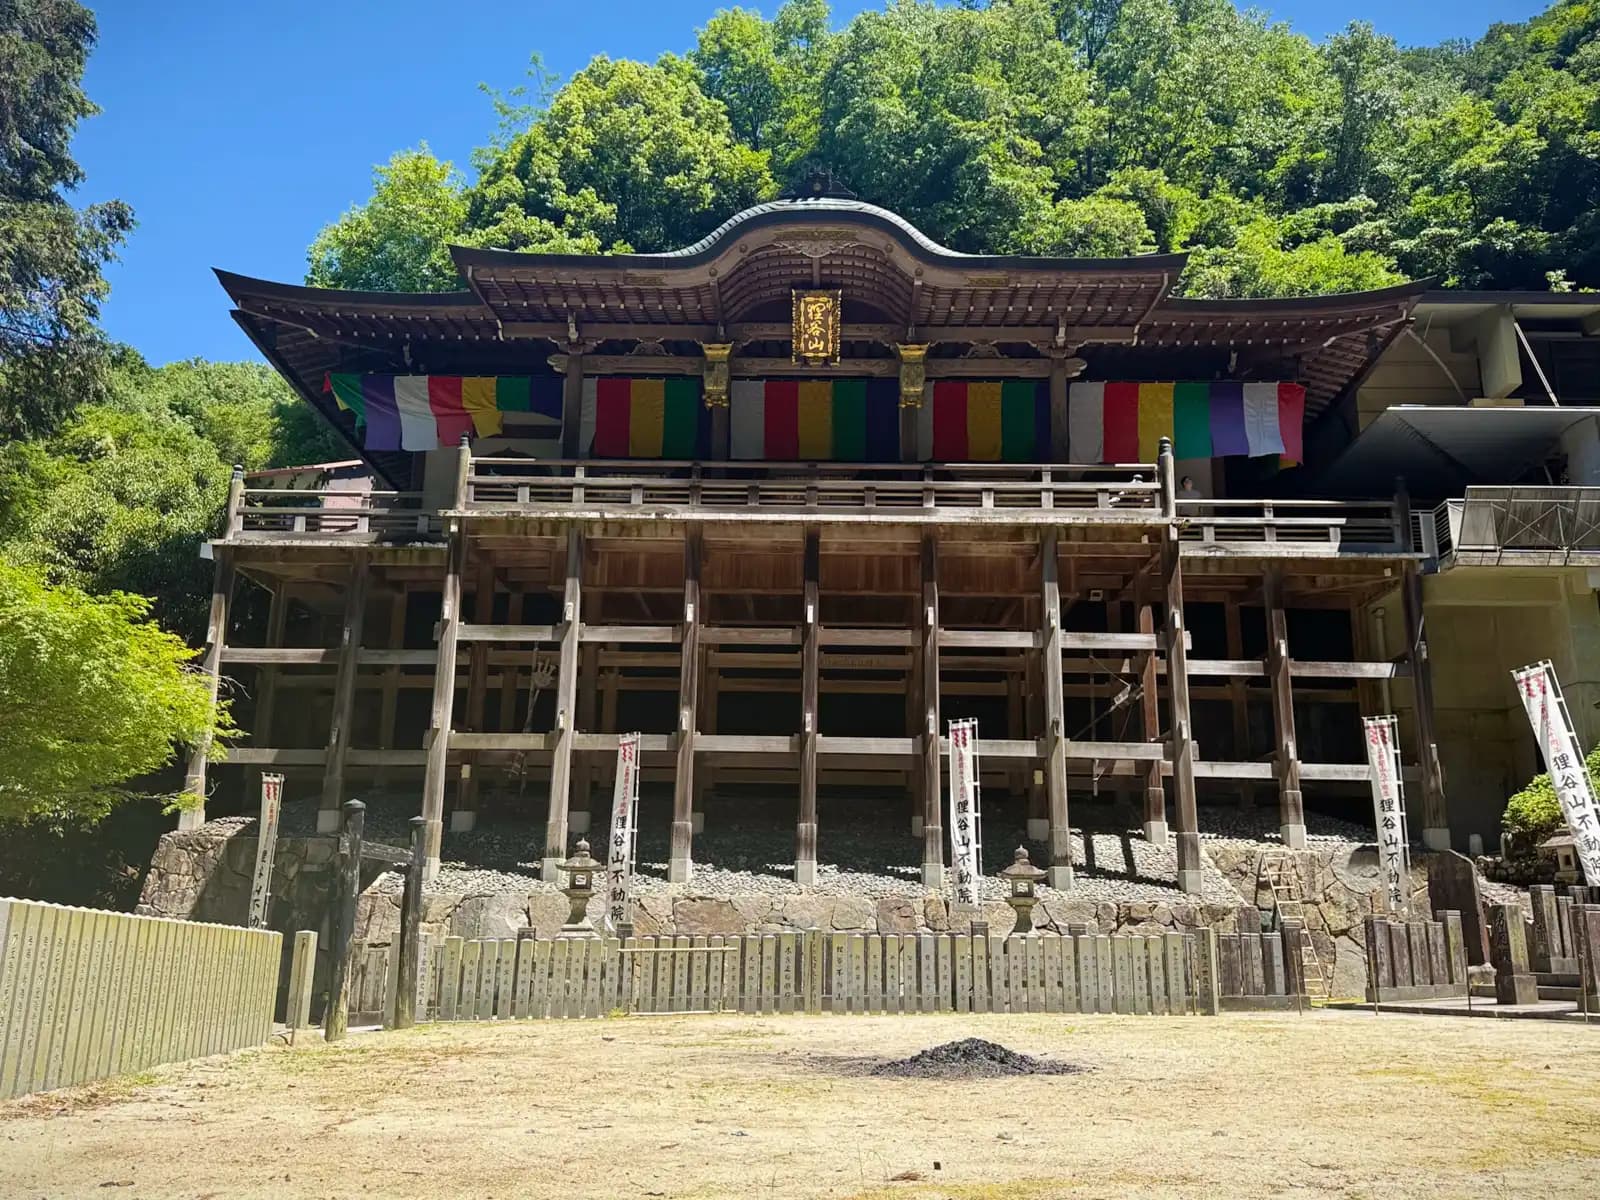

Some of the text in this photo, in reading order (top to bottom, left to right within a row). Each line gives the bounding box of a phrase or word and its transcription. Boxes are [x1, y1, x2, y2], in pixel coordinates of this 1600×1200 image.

[610, 815, 626, 921] 狸谷山不動院
[956, 800, 973, 904] 狸谷山不動院
[1379, 797, 1402, 903] 狸谷山不動院
